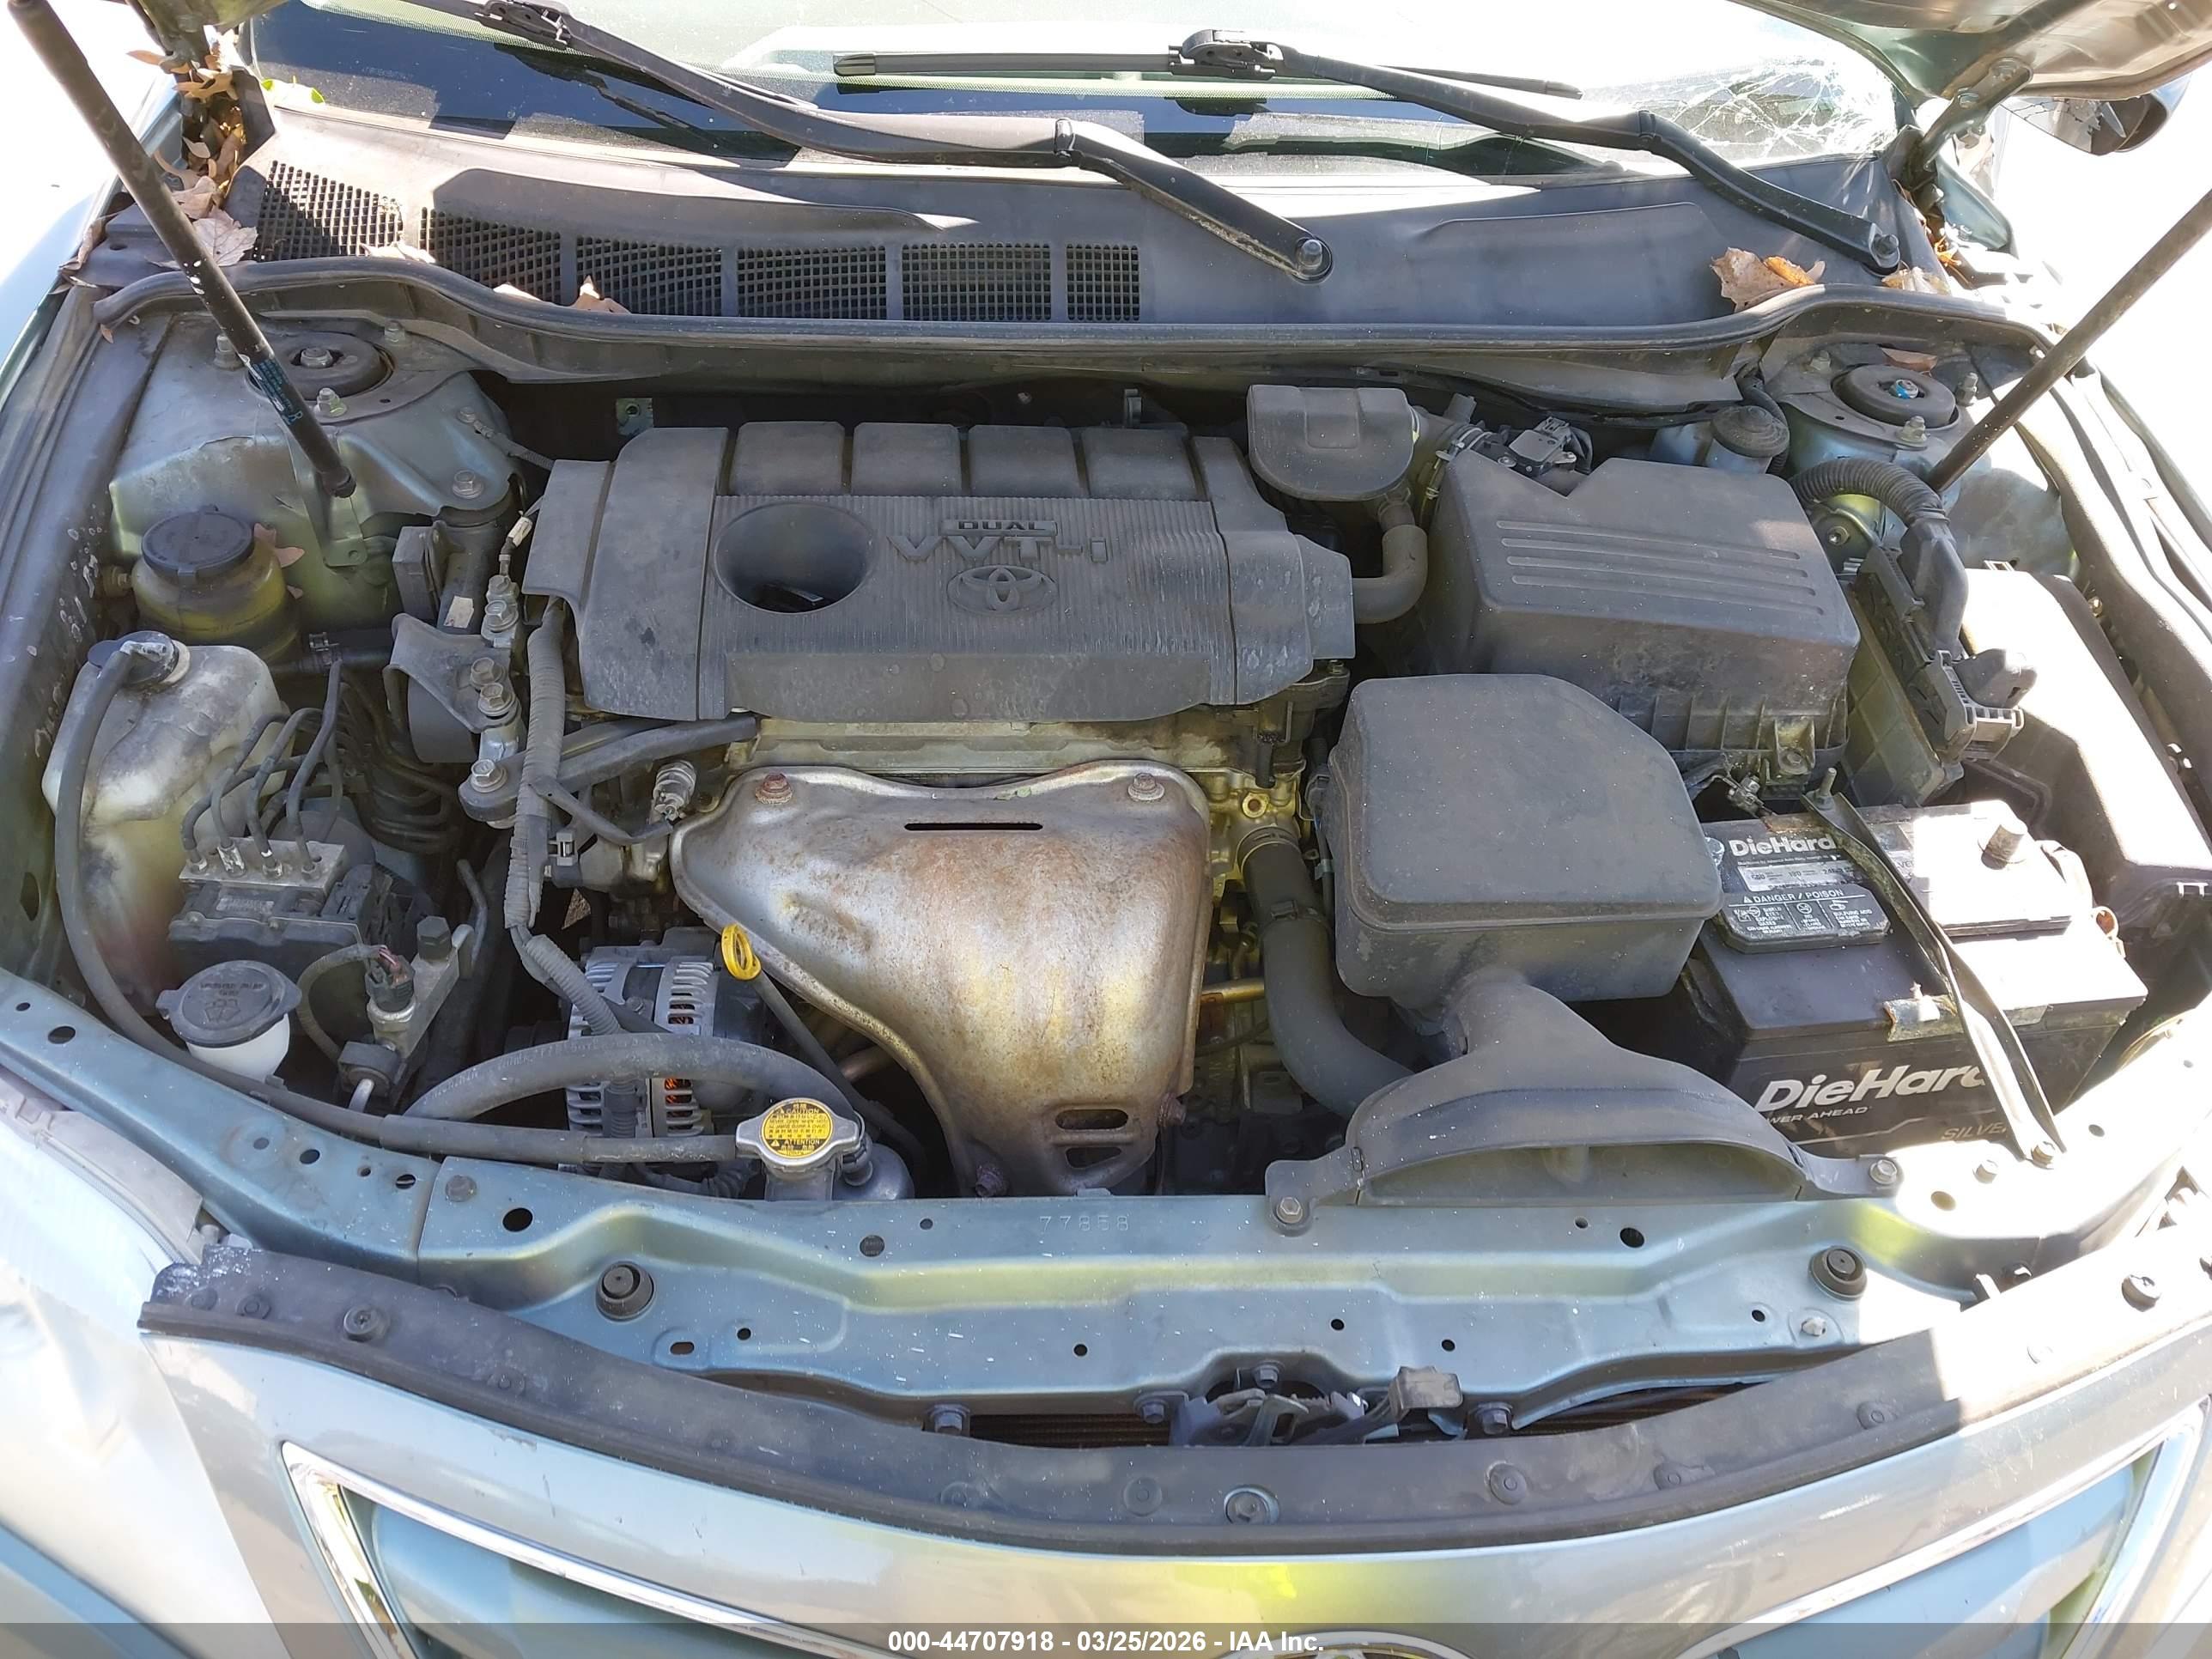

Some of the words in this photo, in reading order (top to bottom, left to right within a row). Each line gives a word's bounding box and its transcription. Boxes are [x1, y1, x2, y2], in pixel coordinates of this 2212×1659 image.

[957, 520, 1054, 531] DUAL
[1729, 834, 1836, 857] DieHard
[1753, 893, 1796, 903] DANGER
[1805, 889, 1844, 899] POISON
[1807, 1106, 1869, 1120] AHEAD
[1941, 1121, 2007, 1140] SILVE
